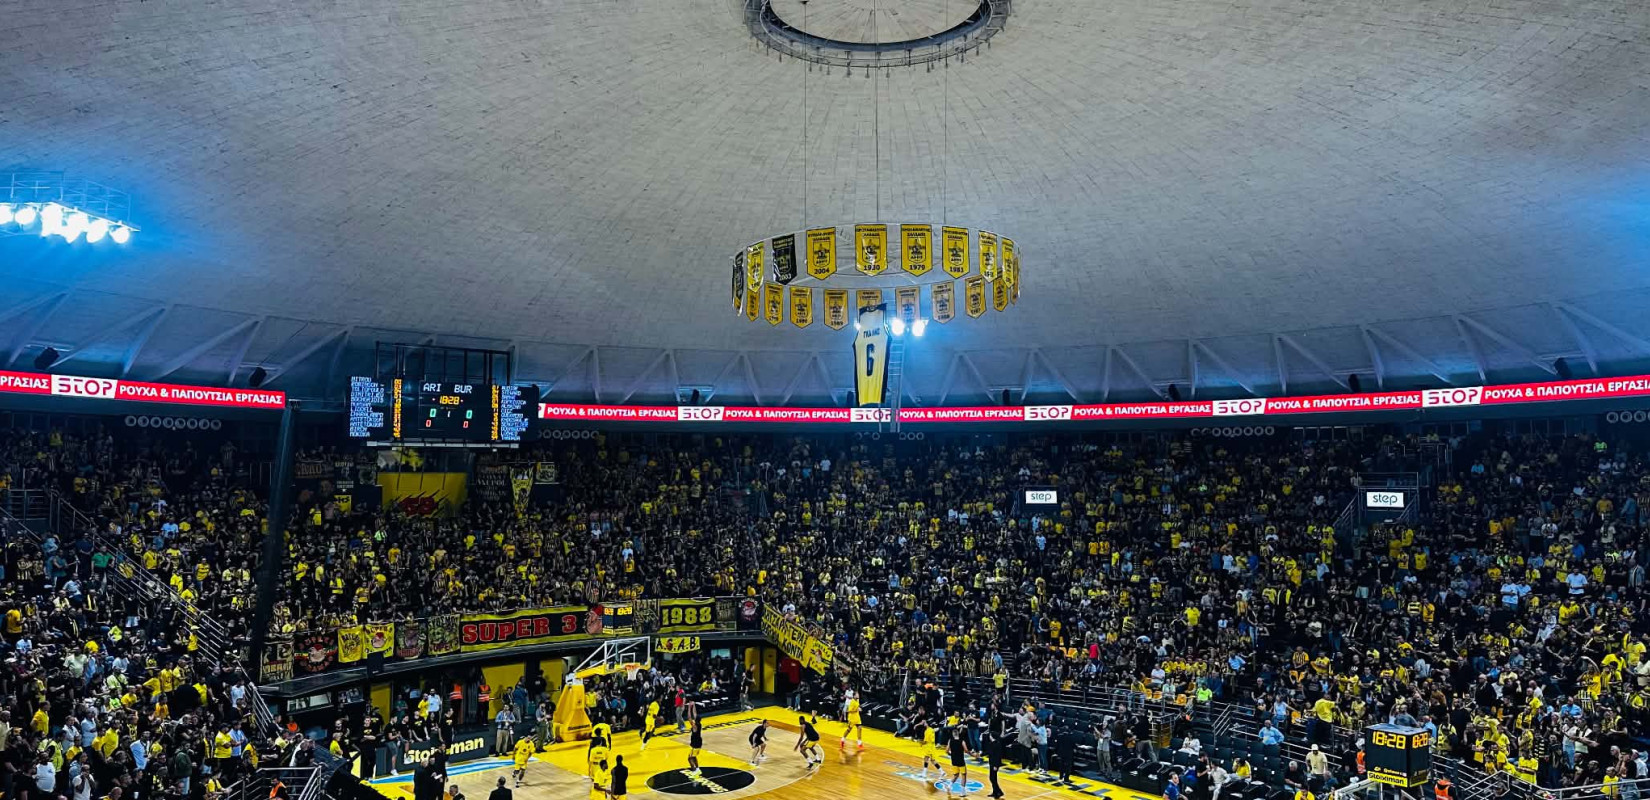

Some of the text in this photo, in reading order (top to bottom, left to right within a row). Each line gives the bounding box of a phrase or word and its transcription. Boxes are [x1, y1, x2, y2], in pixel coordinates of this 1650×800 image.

[866, 343, 875, 377] 6
[423, 382, 442, 392] ARI
[453, 384, 473, 394] BUR
[119, 384, 158, 397] ΡΟΥΧΑ
[160, 387, 169, 398] &
[171, 388, 234, 402] ΠΑΠΟΥΤΣΙΑ
[235, 392, 283, 405] ΕΡΓΑΣΙΑΣ
[547, 406, 577, 416] ΡΟΥΧΑ
[579, 407, 586, 416] &
[588, 408, 637, 417] ΠΑΠΟΥΤΣΙΑ
[638, 409, 677, 418] ΕΡΓΑΣΙΑΣ
[725, 409, 753, 418] ΡΟΥΧΑ
[755, 410, 762, 418] &
[763, 410, 811, 419] ΠΑΠΟΥΤΣΙΑ
[812, 410, 849, 419] ΕΡΓΑΣΙΑΣ
[927, 410, 934, 419] &
[935, 409, 984, 418] ΠΑΠΟΥΤΣΙΑ
[984, 409, 1023, 418] ΕΡΓΑΣΙΑΣ
[1074, 407, 1105, 416] ΡΟΥΧΑ
[1106, 407, 1113, 415] &
[1114, 405, 1167, 415] ΠΑΠΟΥΤΣΙΑ
[1168, 404, 1211, 414] ΕΡΓΑΣΙΑΣ
[1267, 400, 1302, 410] ΡΟΥΧΑ
[1303, 399, 1311, 409] &
[1312, 397, 1371, 408] ΠΑΠΟΥΤΣΙΑ
[1372, 394, 1421, 406] ΕΡΓΑΣΙΑΣ
[1484, 388, 1523, 400] ΡΟΥΧΑ
[1525, 387, 1535, 397] &
[1536, 382, 1606, 397] ΠΑΠΟΥΤΣΙΑ
[430, 408, 437, 418] 0
[466, 409, 473, 419] 0
[425, 419, 432, 427] 0
[462, 420, 469, 428] 0
[1031, 492, 1052, 502] step
[1372, 493, 1398, 505] step
[662, 607, 712, 626] 1988
[462, 617, 551, 643] SUPER
[562, 614, 577, 633] 3
[1372, 731, 1406, 750] 18:28
